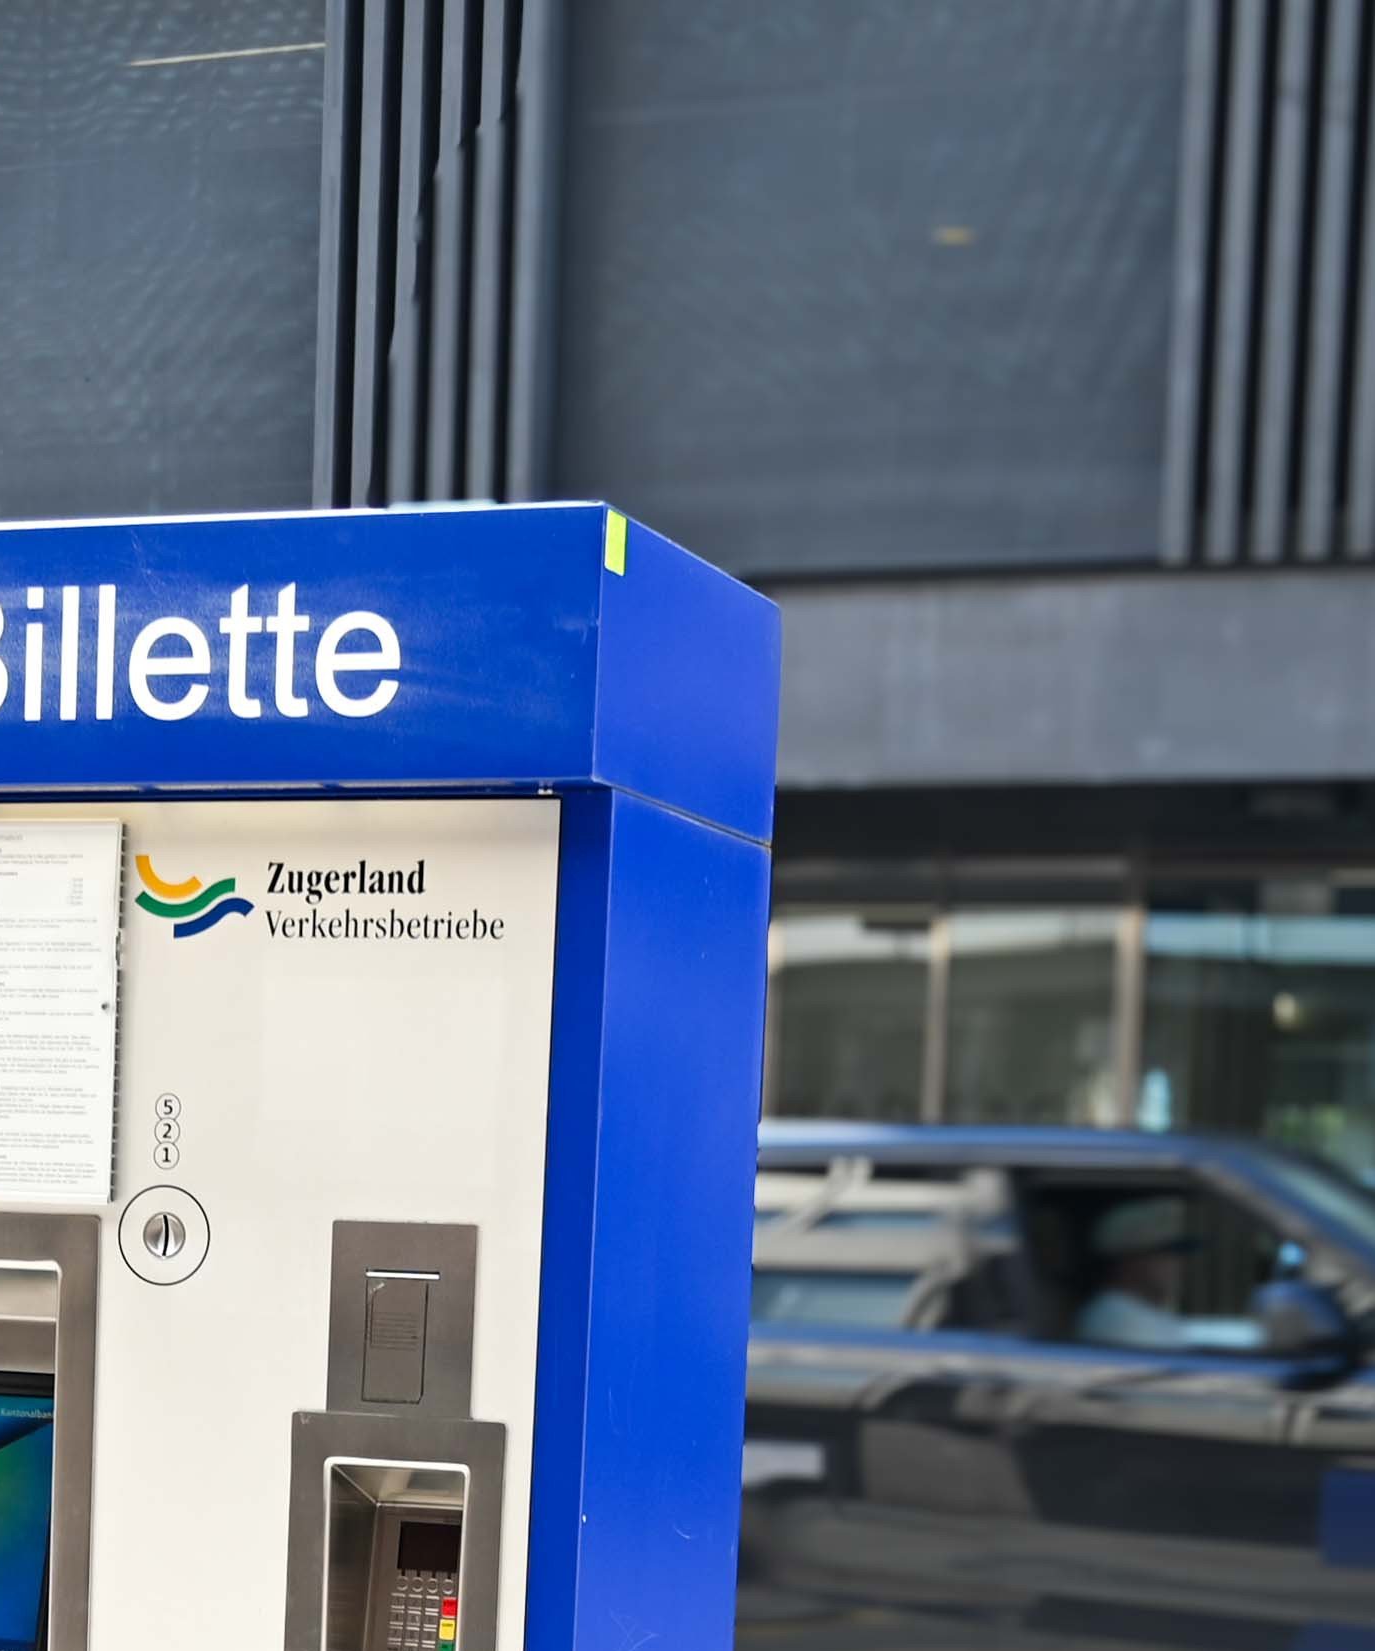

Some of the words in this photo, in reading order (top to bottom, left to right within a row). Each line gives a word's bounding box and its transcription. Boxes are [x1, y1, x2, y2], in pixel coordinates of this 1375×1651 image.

[267, 859, 425, 903] Zugerland
[265, 908, 505, 940] Verkehrsbetriebe
[163, 1099, 173, 1115] 5
[162, 1123, 172, 1139] 2
[162, 1147, 171, 1163] 1
[0, 1407, 54, 1419] Kantonalban
